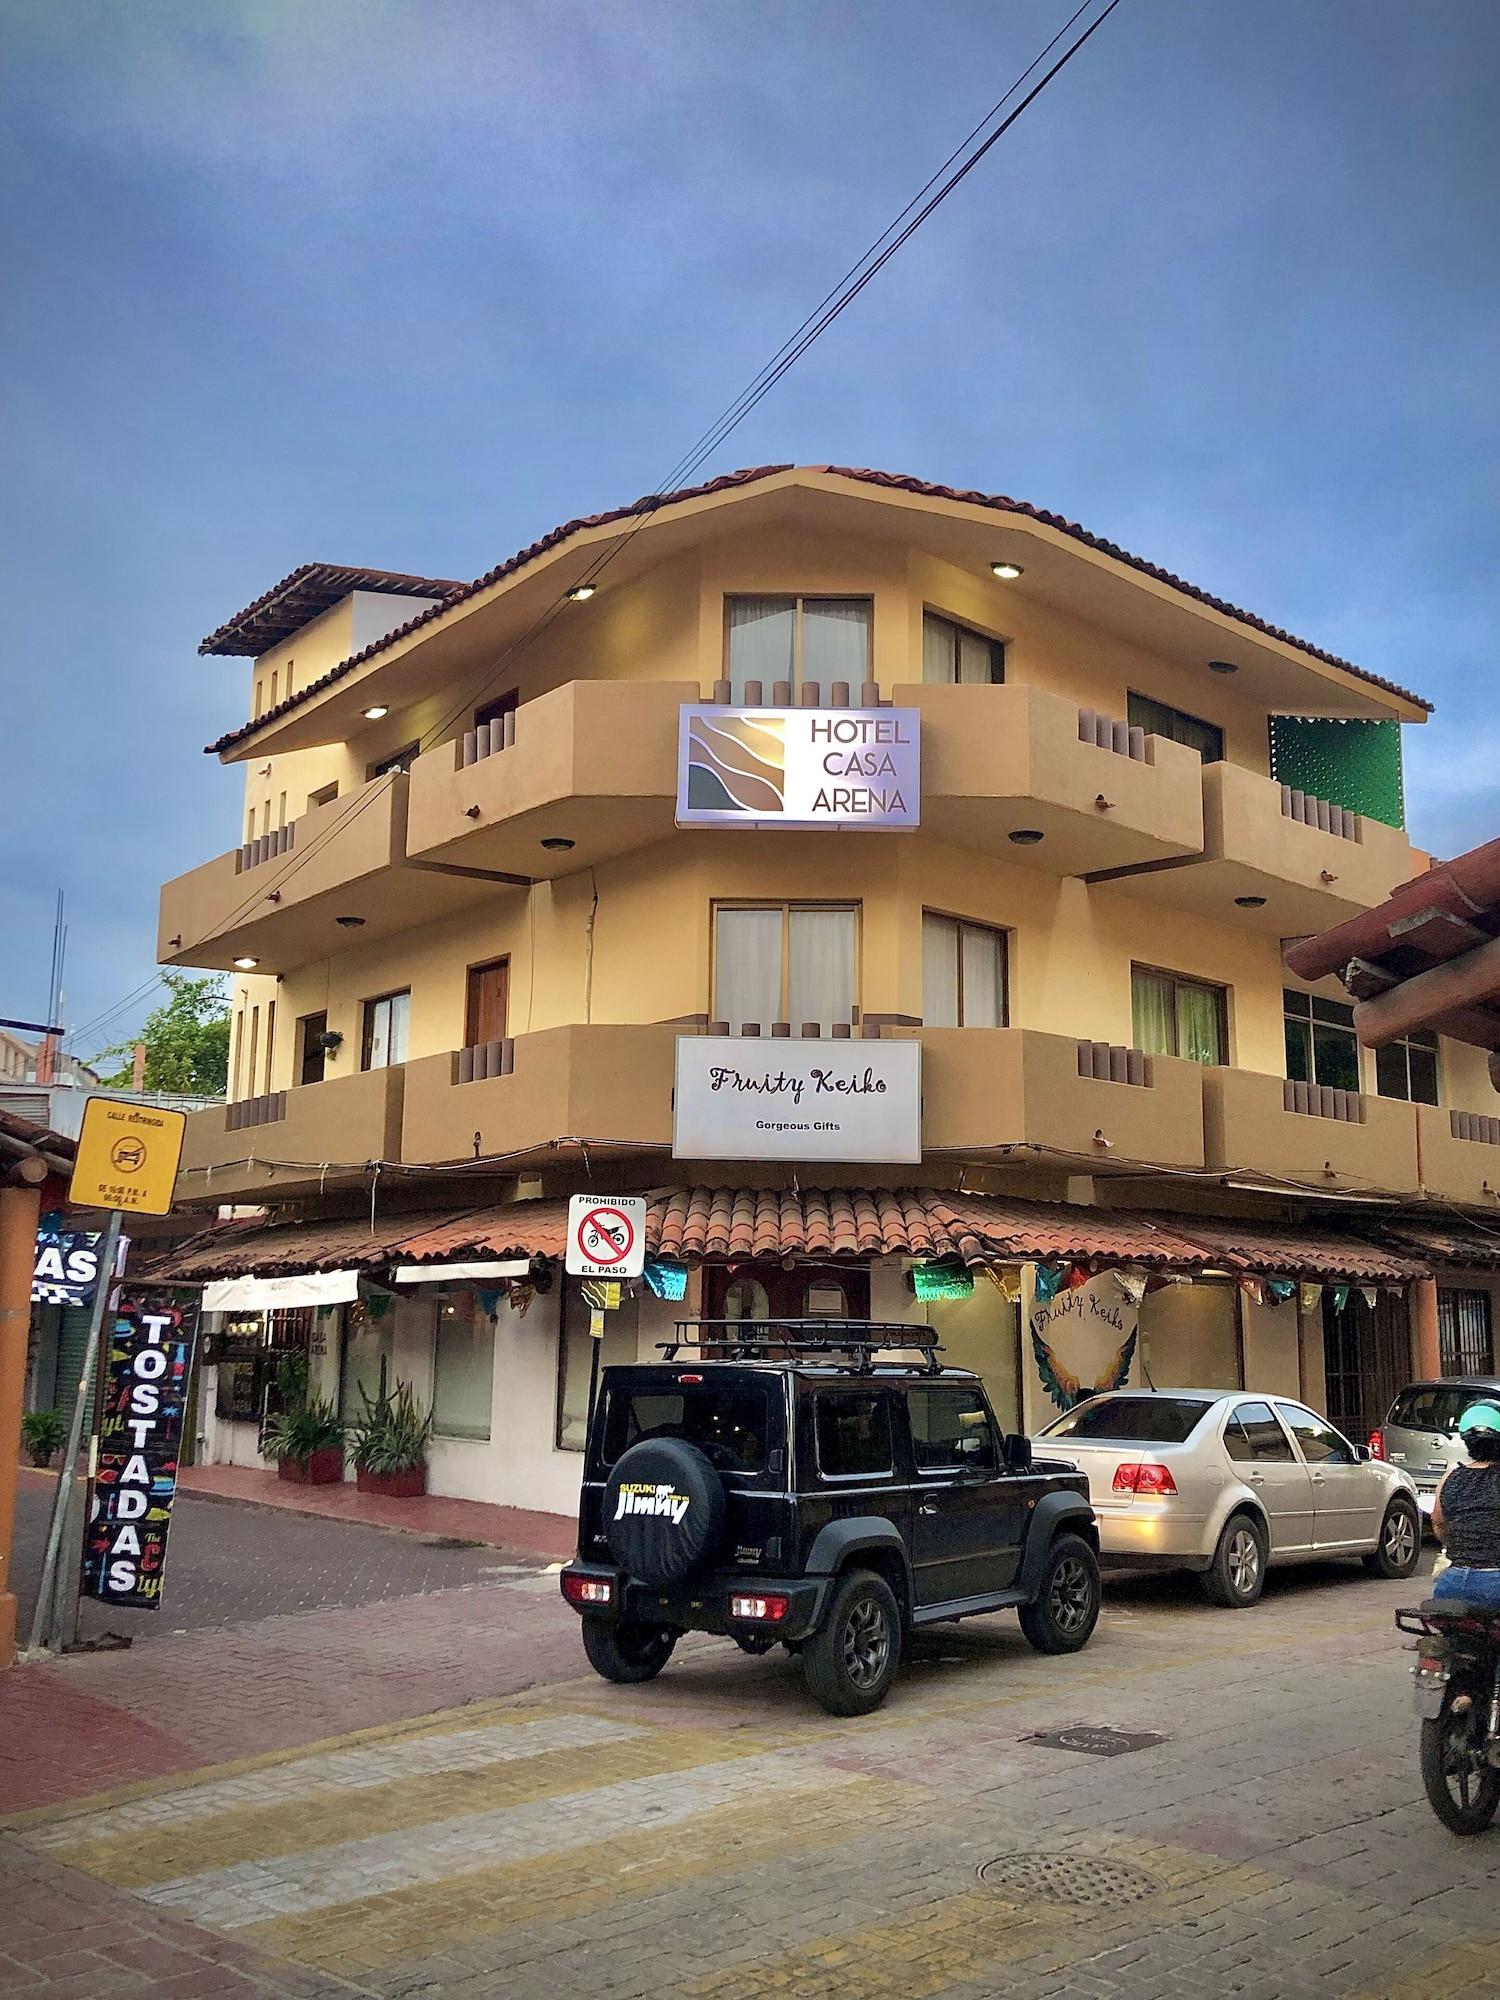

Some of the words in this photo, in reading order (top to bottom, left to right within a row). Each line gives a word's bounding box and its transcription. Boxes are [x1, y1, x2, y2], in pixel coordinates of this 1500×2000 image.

[811, 719, 911, 744] HOTEL
[822, 751, 897, 777] CASA
[811, 787, 908, 814] ARENA
[709, 1067, 805, 1105] Fruity
[810, 1067, 887, 1095] Keiko
[107, 1111, 126, 1121] CALLE
[755, 1120, 810, 1132] Gorgeous
[813, 1121, 841, 1132] Gifts
[578, 1196, 637, 1207] PROHIBIDO
[33, 1246, 98, 1283] AS
[581, 1265, 595, 1274] EL
[598, 1265, 627, 1275] PASO
[1034, 1290, 1085, 1332] Fruity
[108, 1315, 171, 1592] TOSTADAS
[619, 1483, 656, 1494] SUZUKI
[613, 1491, 690, 1525] Jimny
